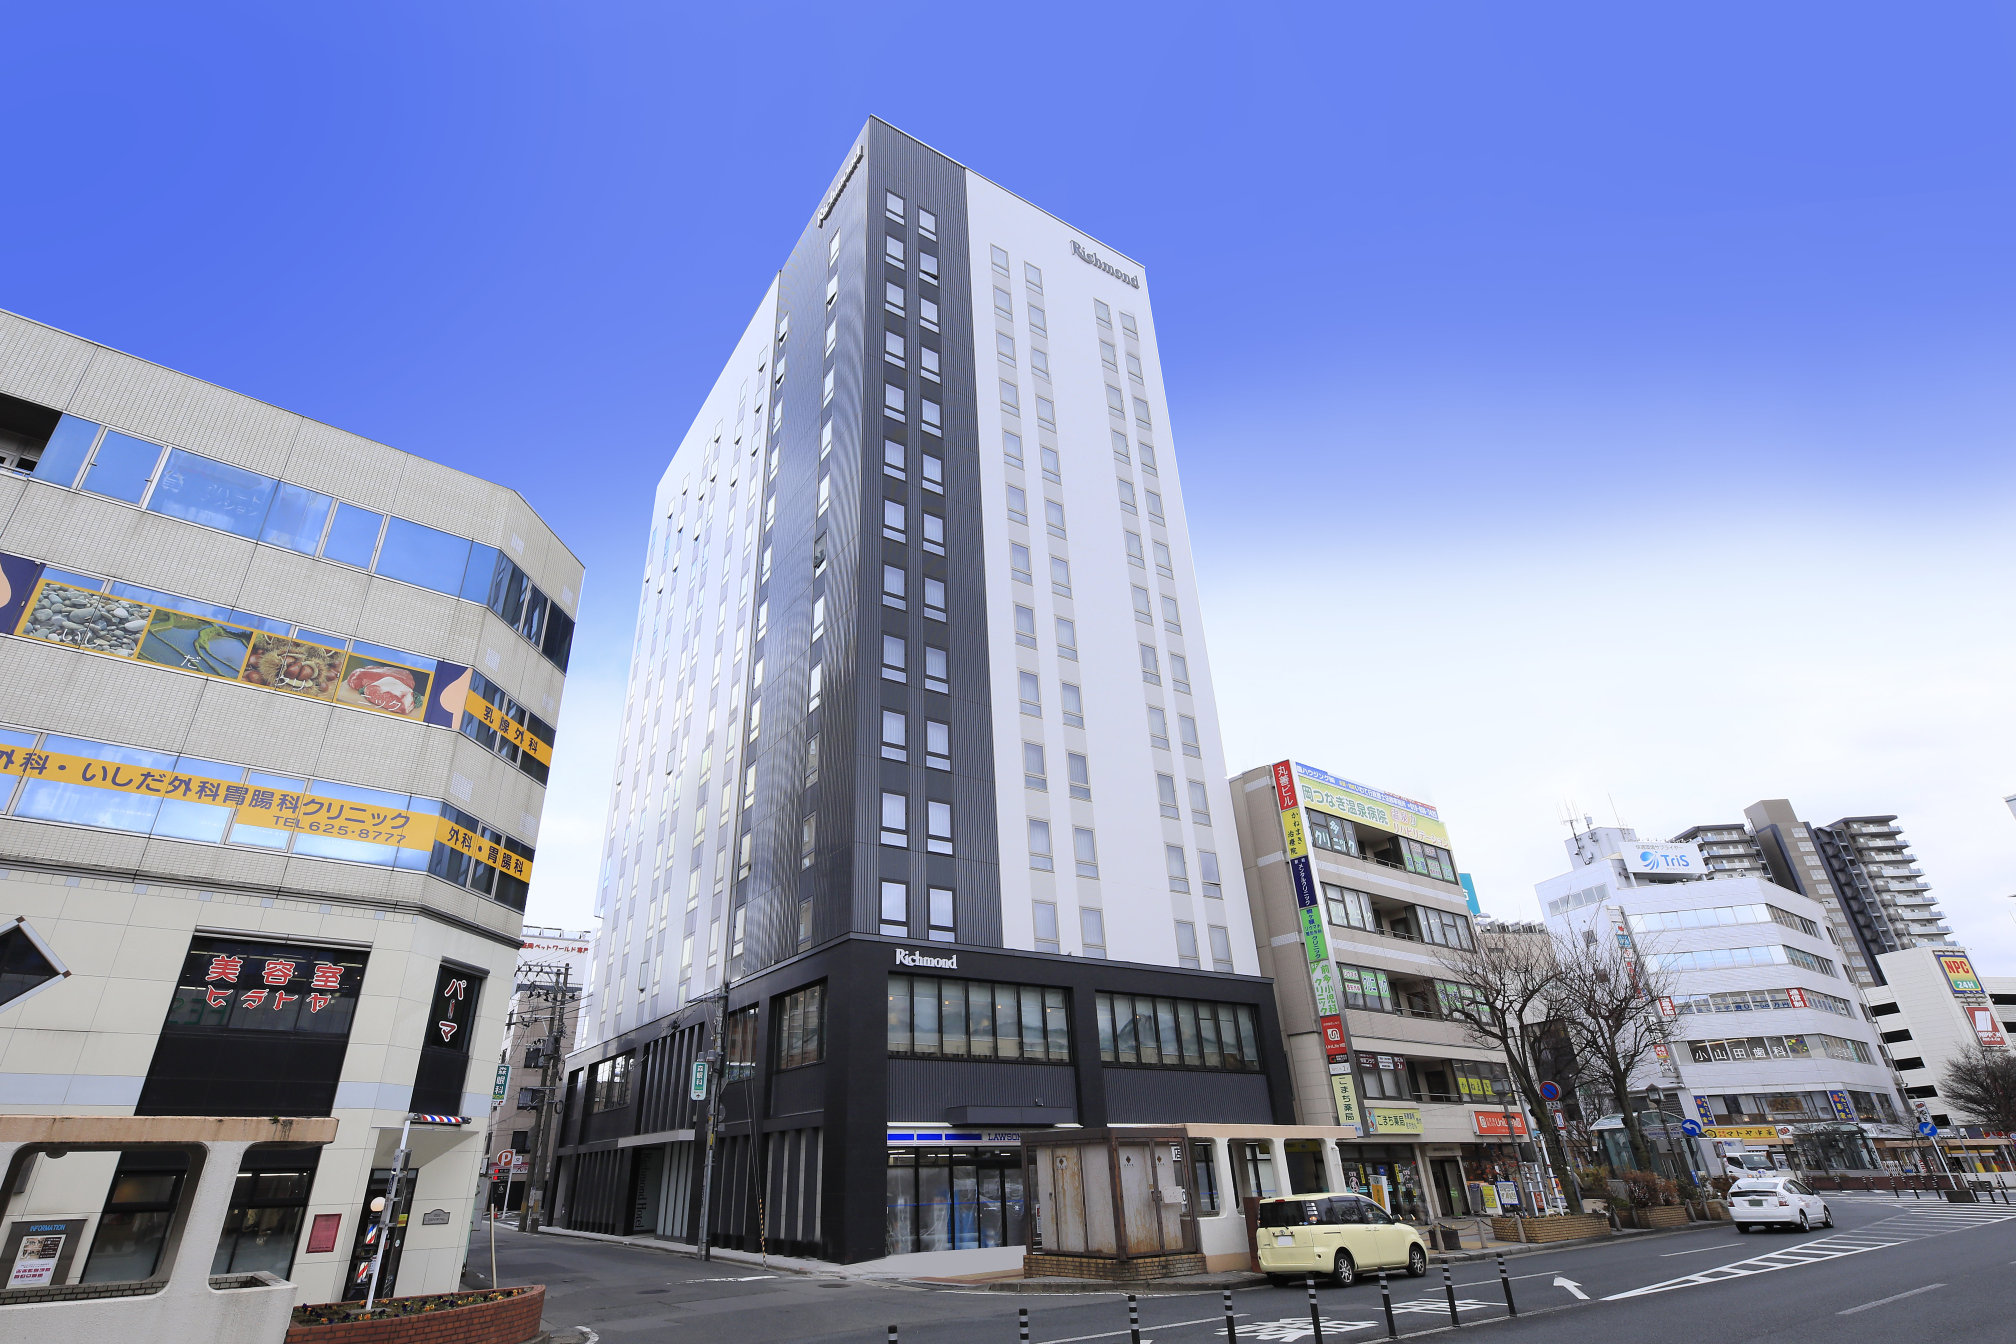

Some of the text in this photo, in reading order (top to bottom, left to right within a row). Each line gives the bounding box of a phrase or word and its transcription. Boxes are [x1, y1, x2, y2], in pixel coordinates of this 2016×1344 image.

[1070, 239, 1140, 290] Richmond
[62, 628, 99, 647] いし
[180, 654, 201, 669] だ
[357, 694, 401, 711] ニック
[483, 705, 538, 754] 乳腺外科
[1277, 765, 1294, 807] 丸善ビル
[1291, 812, 1303, 845] かねまき
[1393, 822, 1449, 848] リハビリテーション
[447, 826, 524, 876] 外科・胃腸科
[1287, 830, 1298, 855] 治療院
[1315, 830, 1355, 854] クリニック
[1660, 853, 1690, 867] TriS
[1298, 862, 1311, 906] メンタルクリニック
[894, 948, 957, 969] Richmond
[1311, 935, 1321, 959] クリニック
[205, 955, 344, 990] 美容室
[1944, 960, 1970, 974] NPC
[1315, 979, 1328, 1015] クリニック
[1320, 964, 1338, 1014] 前多小児科
[1957, 981, 1975, 989] 24H
[439, 979, 467, 1041] パーマ
[1695, 1046, 1786, 1061] 小山田歯科
[494, 1066, 509, 1095] 森眼科
[1461, 1081, 1491, 1092] かねまき
[1338, 1076, 1354, 1121] こまち薬局
[1377, 1115, 1405, 1126] こまち薬局
[500, 1152, 511, 1167] P
[30, 1224, 67, 1232] INFORMATION
[634, 1202, 647, 1228] Hotel
